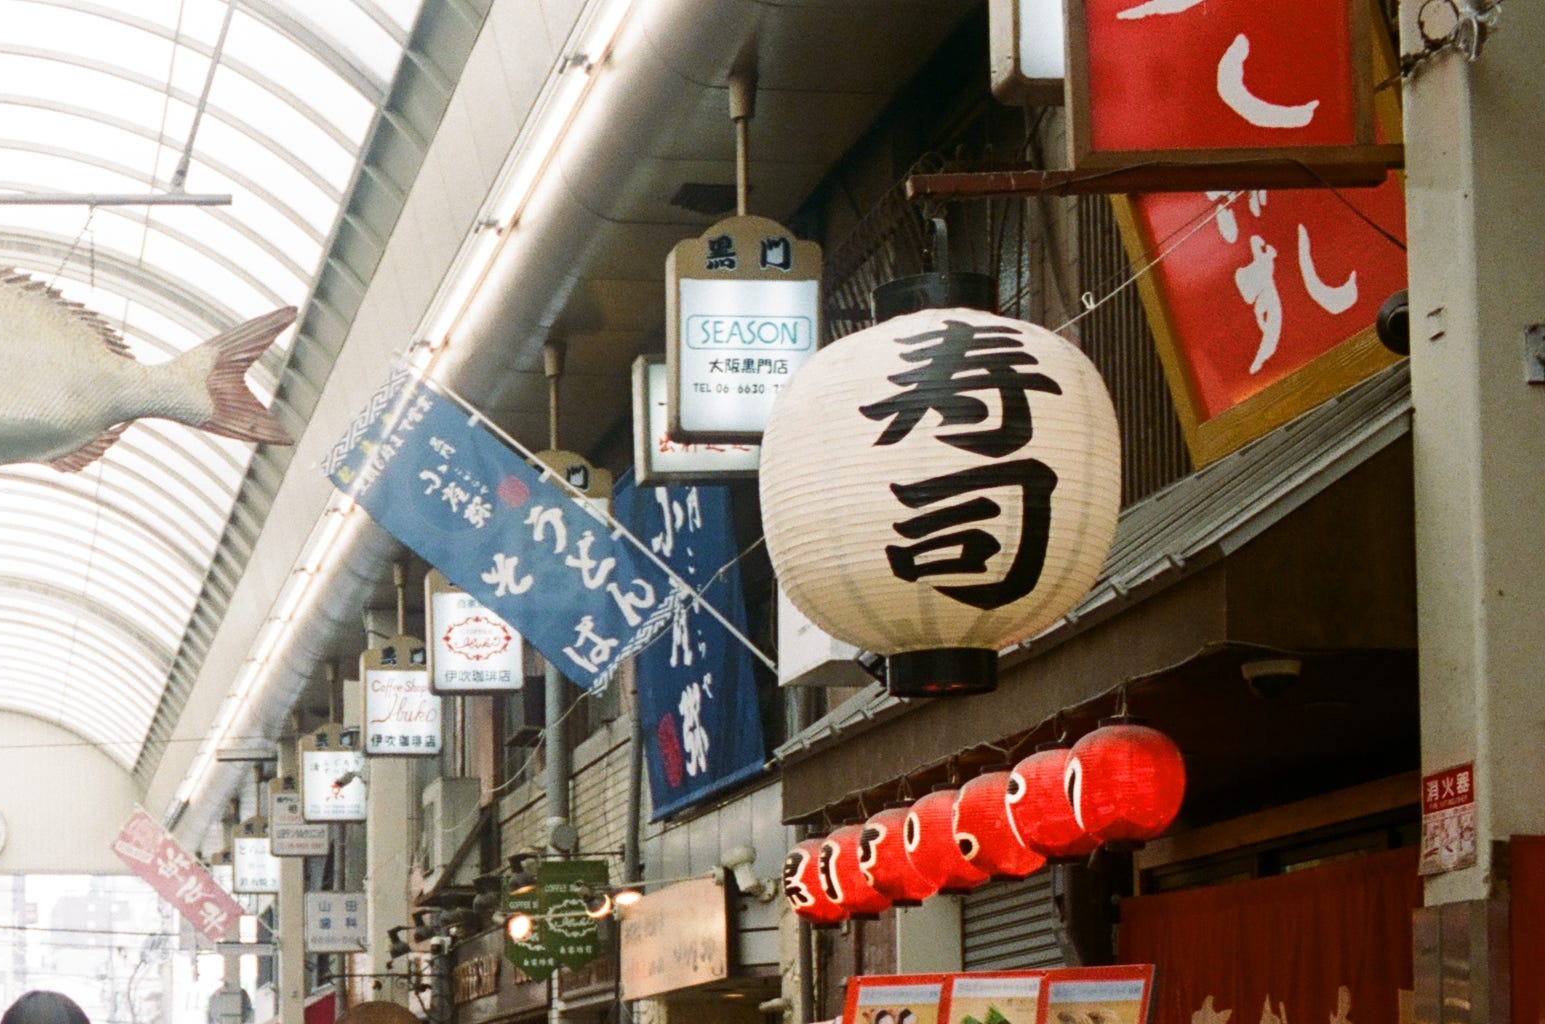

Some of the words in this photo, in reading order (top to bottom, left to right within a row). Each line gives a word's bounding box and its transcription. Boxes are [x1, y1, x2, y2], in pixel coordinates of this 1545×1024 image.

[700, 319, 799, 345] SEASON
[708, 358, 789, 375] 大阪黒門店
[693, 382, 712, 394] TEL
[858, 319, 1063, 611] 寿司
[524, 505, 656, 627] うどん
[370, 734, 436, 748] 伊吹珈琲店
[1426, 770, 1471, 803] 消火器
[318, 900, 358, 913] 山田
